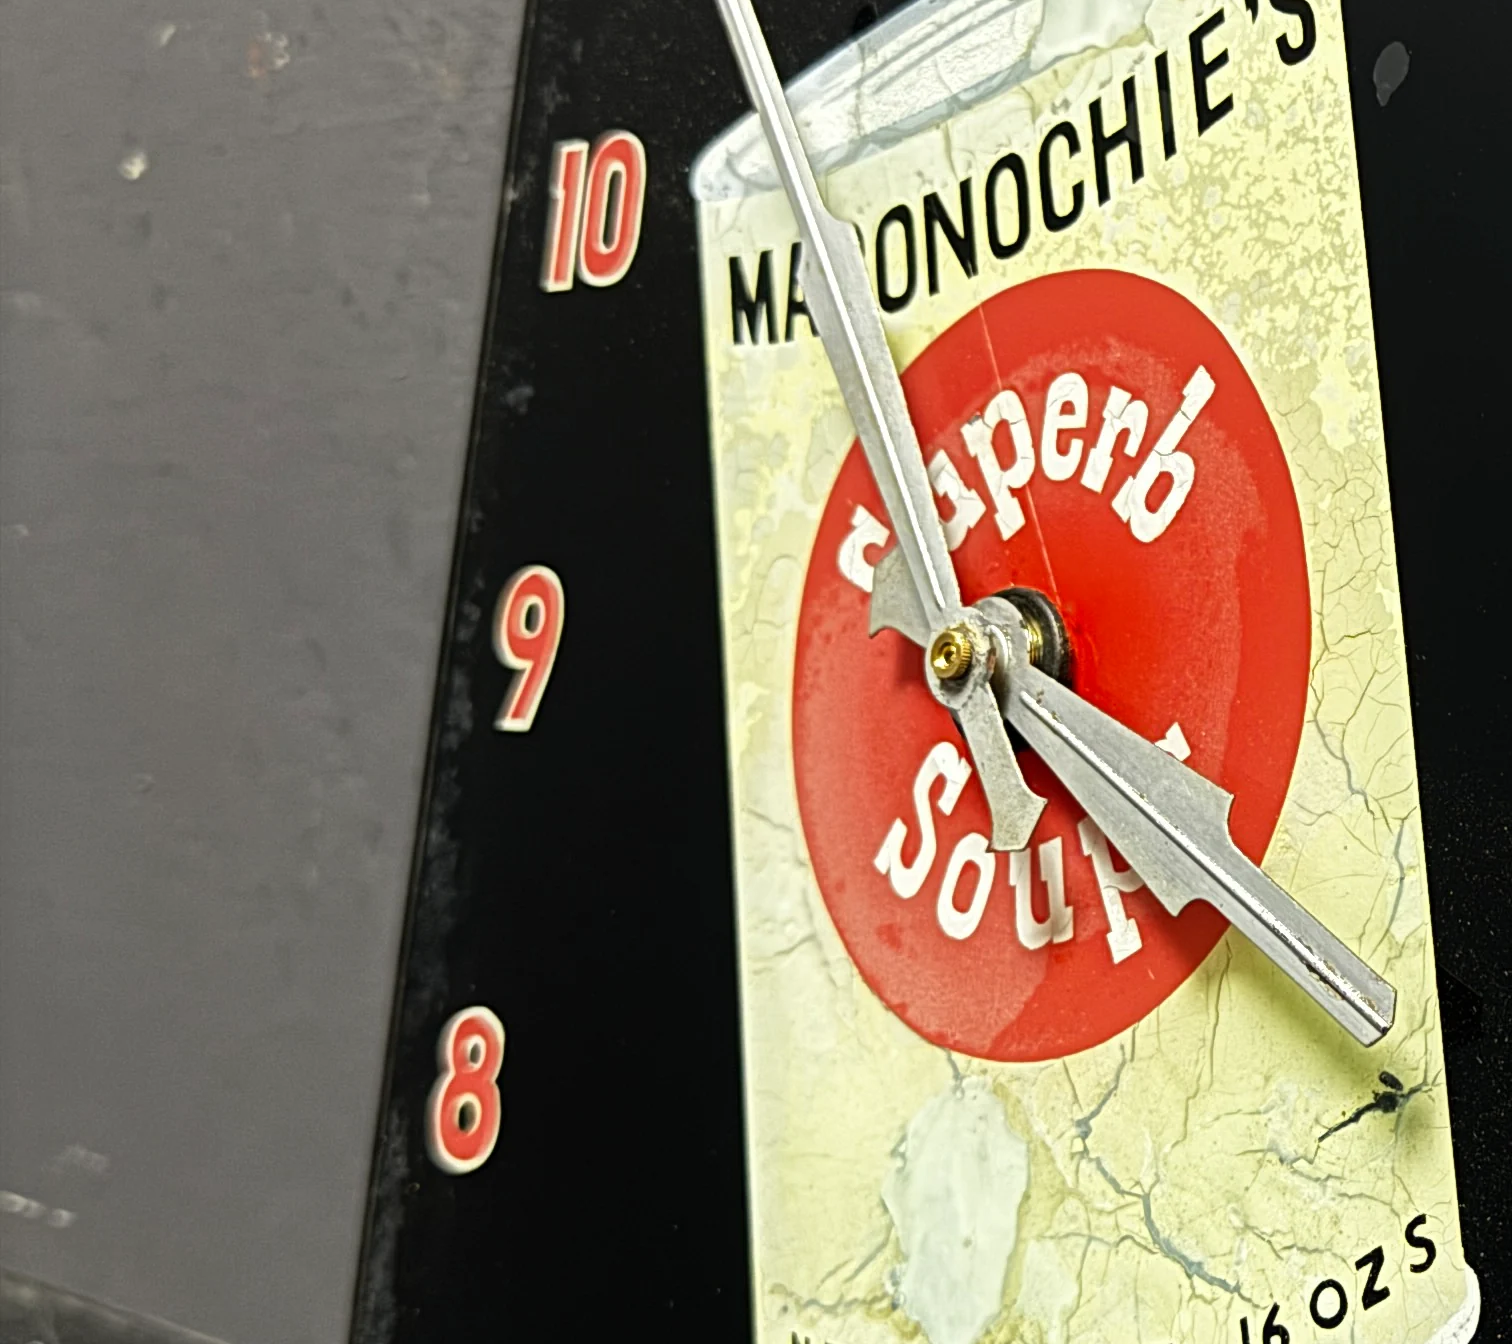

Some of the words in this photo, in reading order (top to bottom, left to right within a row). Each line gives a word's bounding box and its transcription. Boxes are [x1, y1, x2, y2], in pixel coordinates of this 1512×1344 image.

[541, 131, 647, 293] 10
[495, 565, 565, 732] 9
[873, 720, 1192, 965] Soup
[430, 1005, 506, 1174] 8
